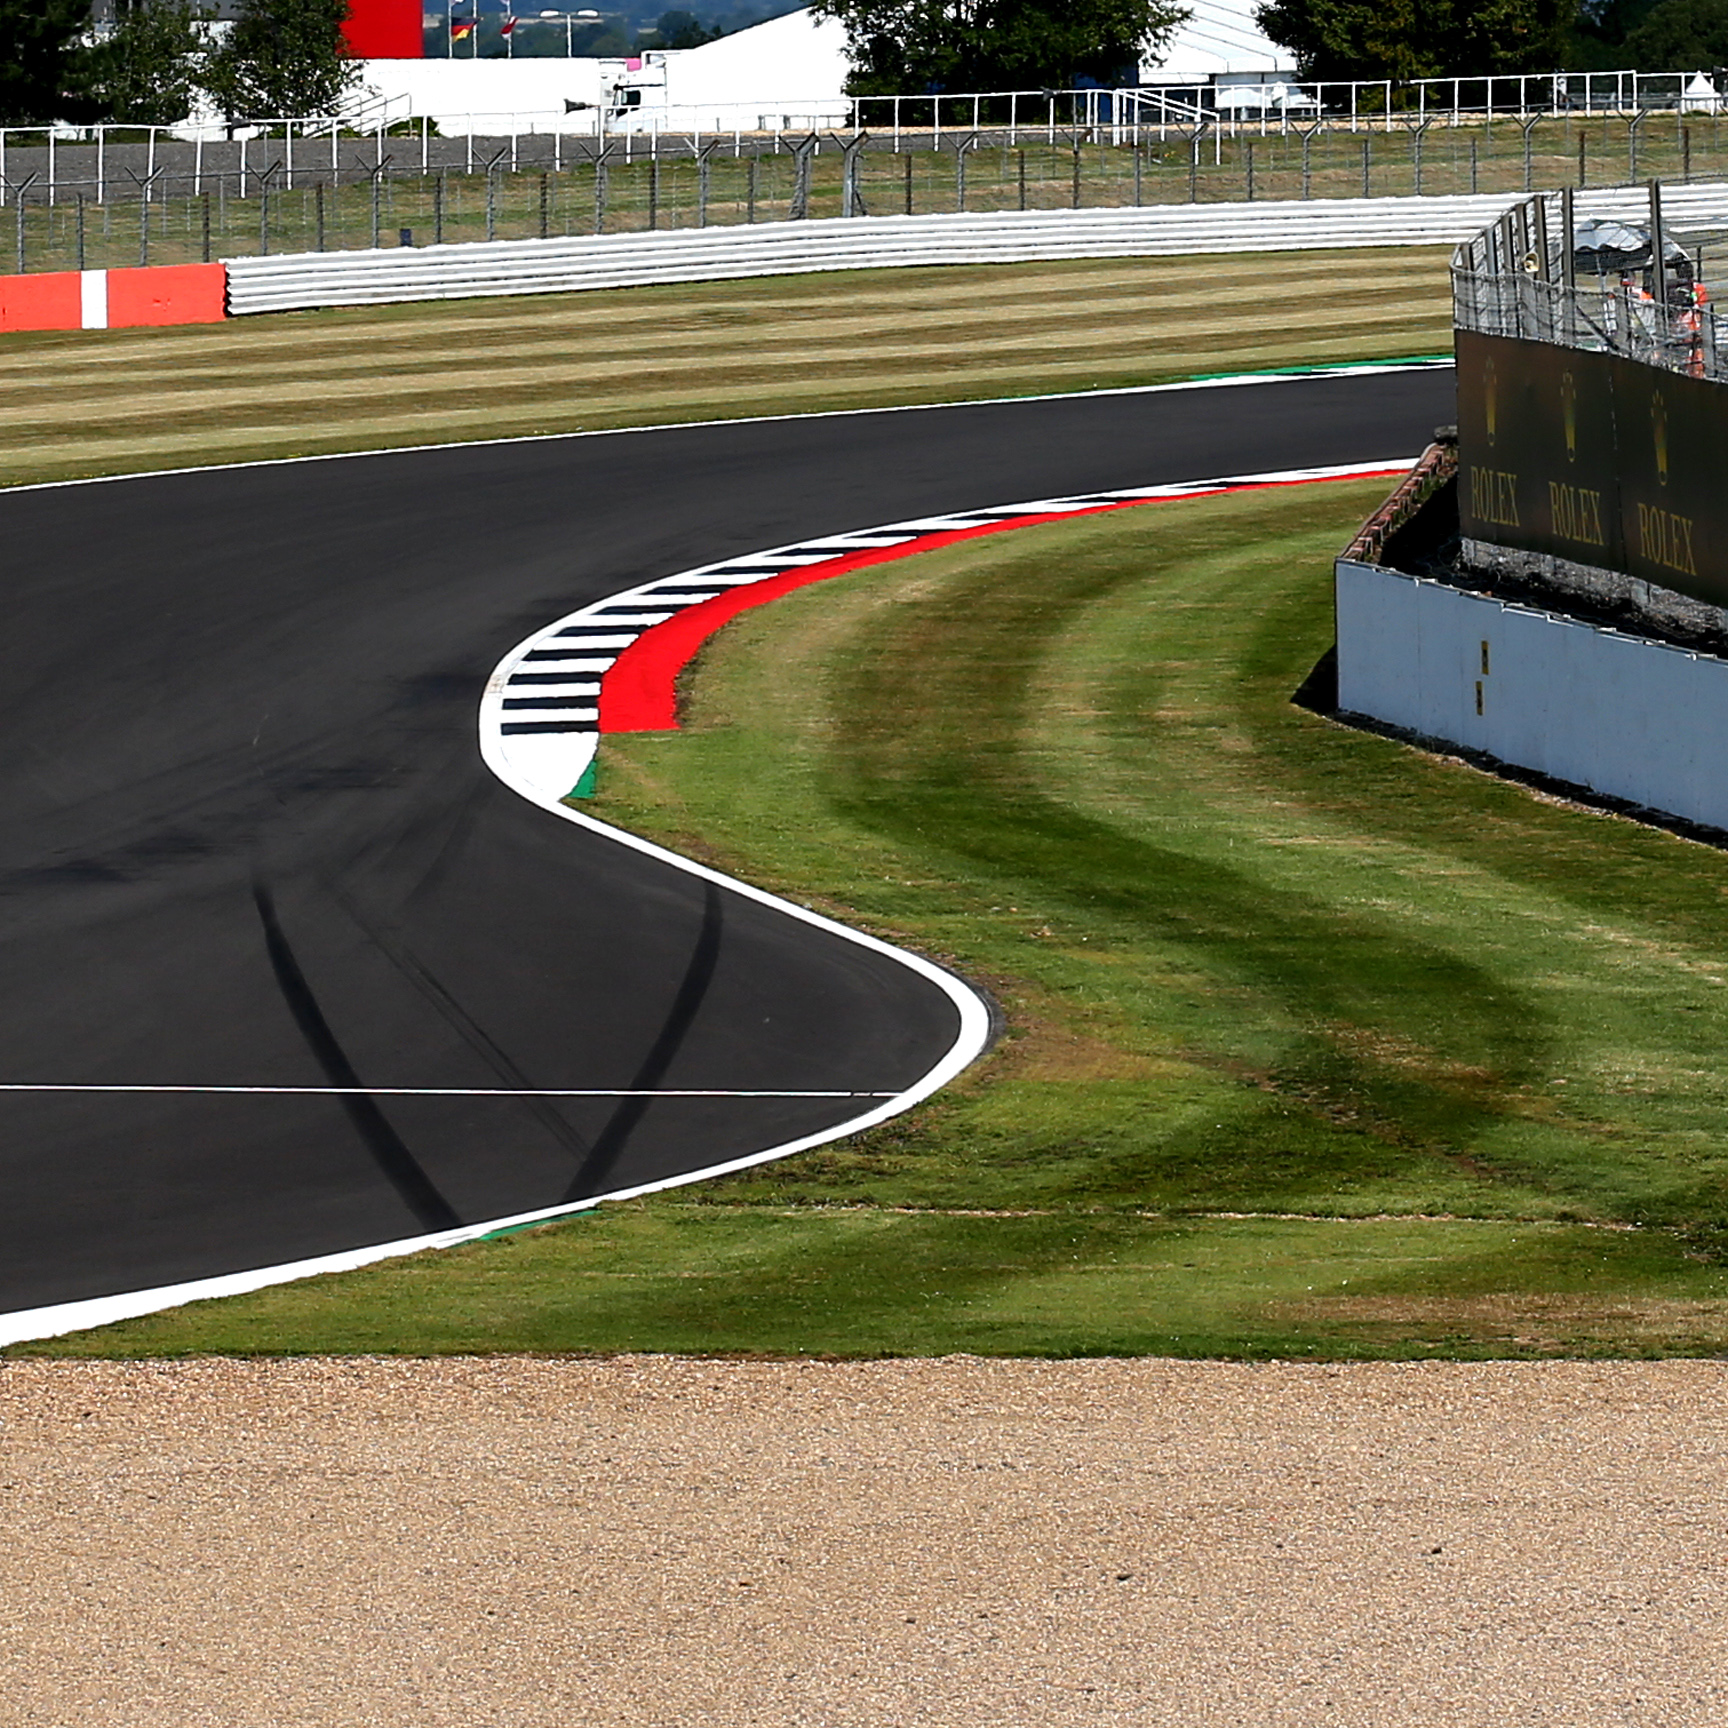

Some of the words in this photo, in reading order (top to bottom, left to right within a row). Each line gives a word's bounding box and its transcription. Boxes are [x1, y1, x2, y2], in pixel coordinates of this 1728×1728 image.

[1471, 466, 1520, 527] ROLEX
[1548, 481, 1605, 546] ROLEX
[1637, 503, 1697, 576] ROLEX
